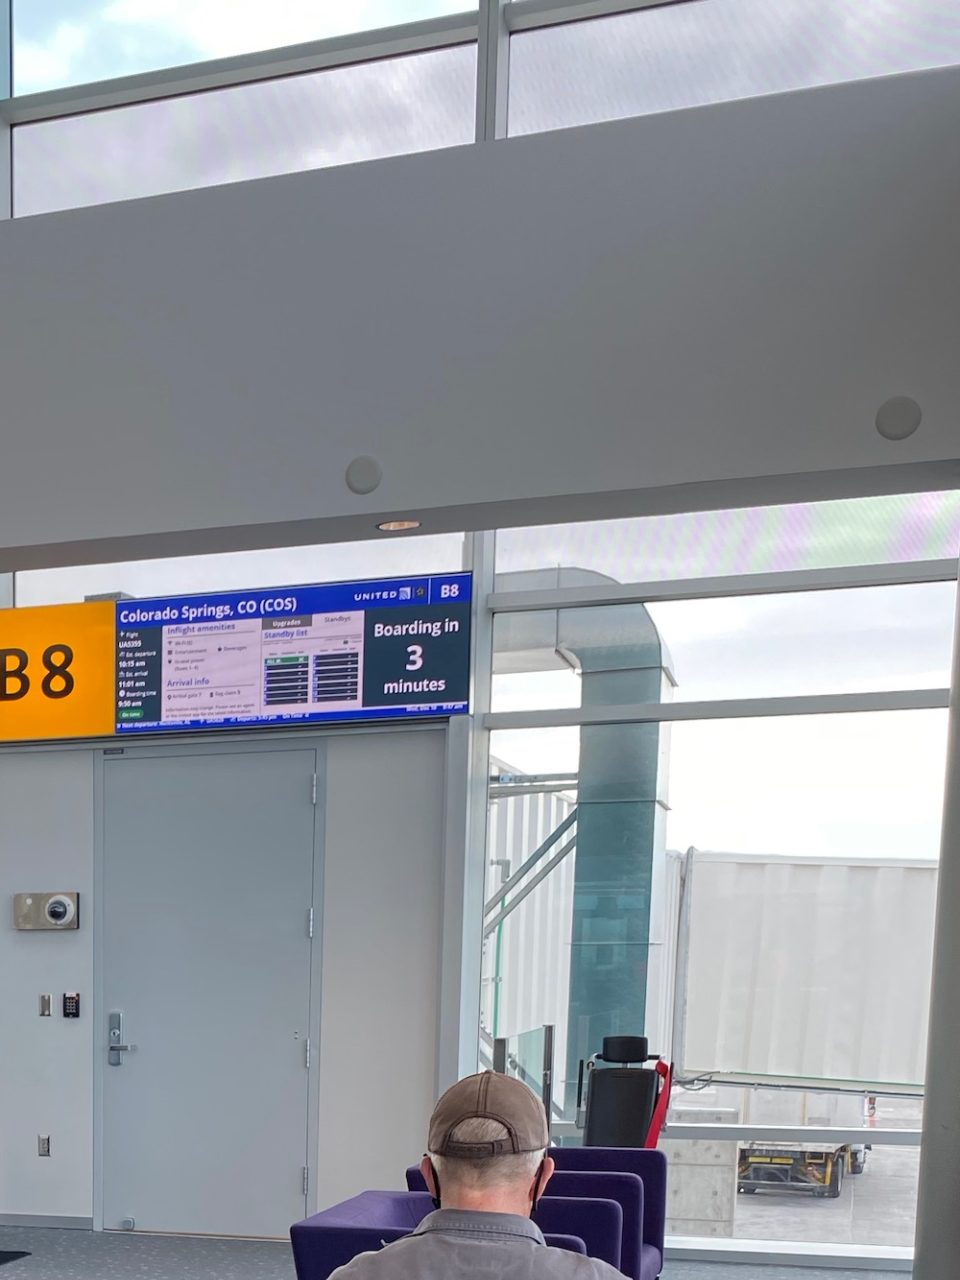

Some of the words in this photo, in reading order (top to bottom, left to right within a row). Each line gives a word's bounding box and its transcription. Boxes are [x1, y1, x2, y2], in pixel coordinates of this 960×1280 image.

[354, 591, 397, 601] UNITED
[440, 584, 460, 599] B8
[120, 607, 179, 623] Colorado
[181, 603, 234, 621] Springs,
[237, 600, 257, 614] CO
[260, 597, 297, 615] (COS)
[167, 625, 195, 635] Inflight
[197, 623, 236, 632] amenities
[272, 619, 302, 628] Upgrades
[374, 620, 441, 638] Boarding
[444, 617, 460, 632] in
[264, 629, 295, 640] Standby
[296, 629, 308, 637] list
[405, 644, 424, 671] 3
[167, 678, 193, 687] Arrival
[194, 677, 210, 686] info
[384, 679, 446, 694] minutes
